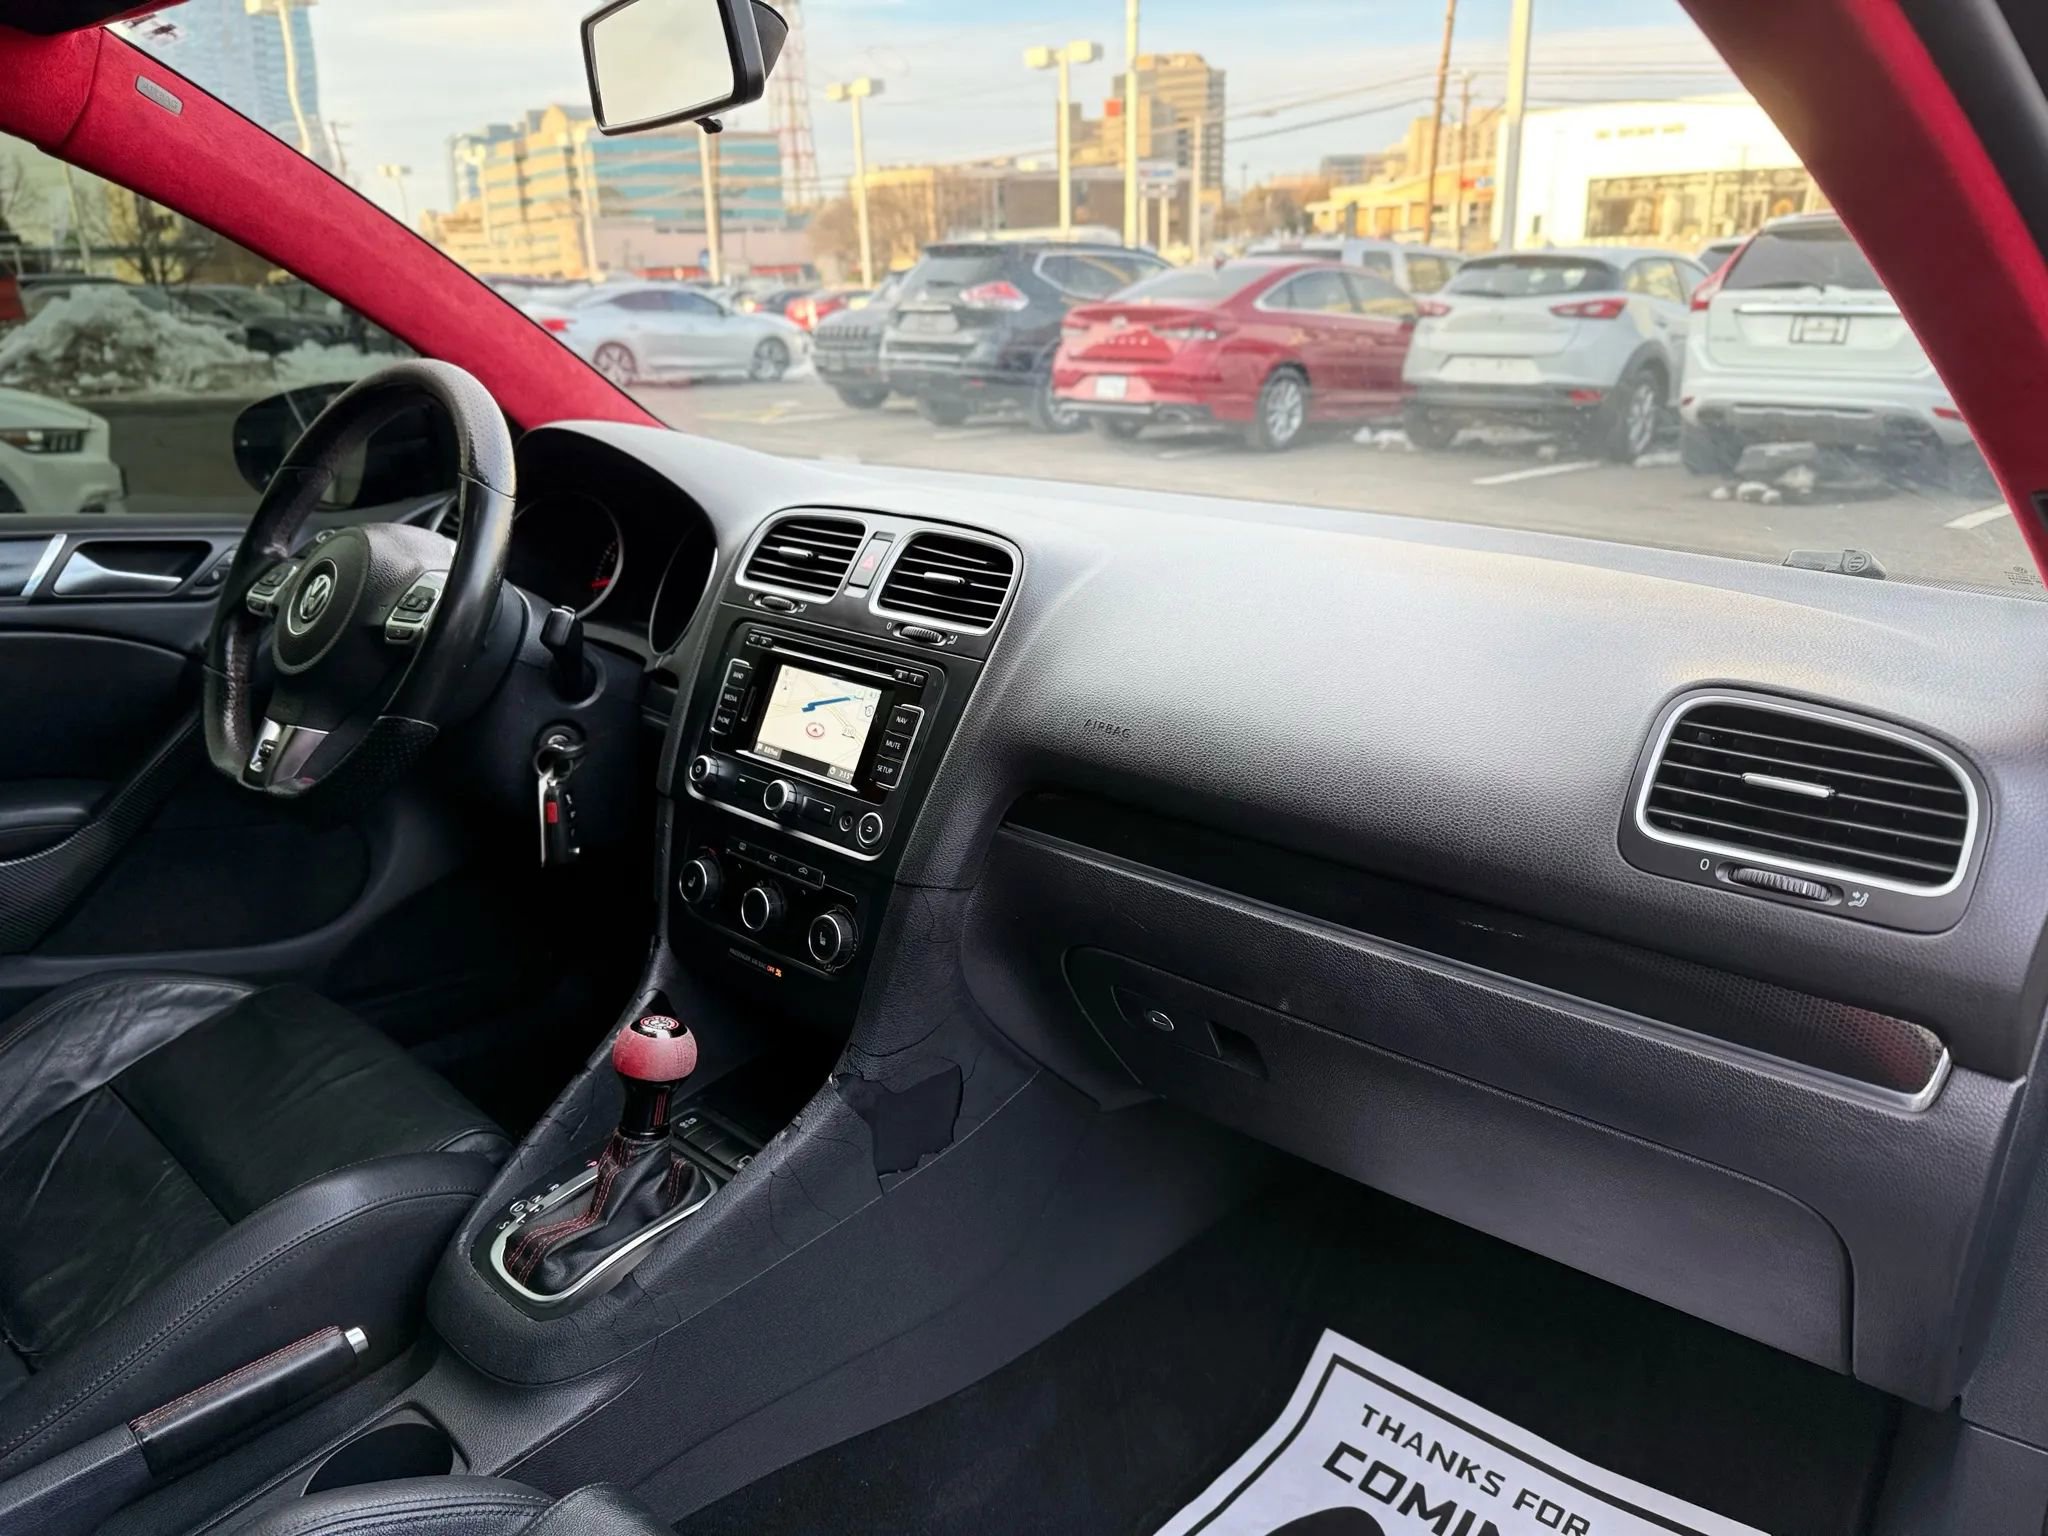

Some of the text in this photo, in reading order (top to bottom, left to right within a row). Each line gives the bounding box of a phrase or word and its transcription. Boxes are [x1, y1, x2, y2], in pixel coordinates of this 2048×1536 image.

[896, 716, 908, 725] NAV
[885, 739, 901, 750] MUTE
[876, 764, 893, 774] SETUP
[1700, 858, 1710, 870] 0
[1361, 1403, 1591, 1536] THANKS FOR
[1322, 1440, 1500, 1536] COMI
